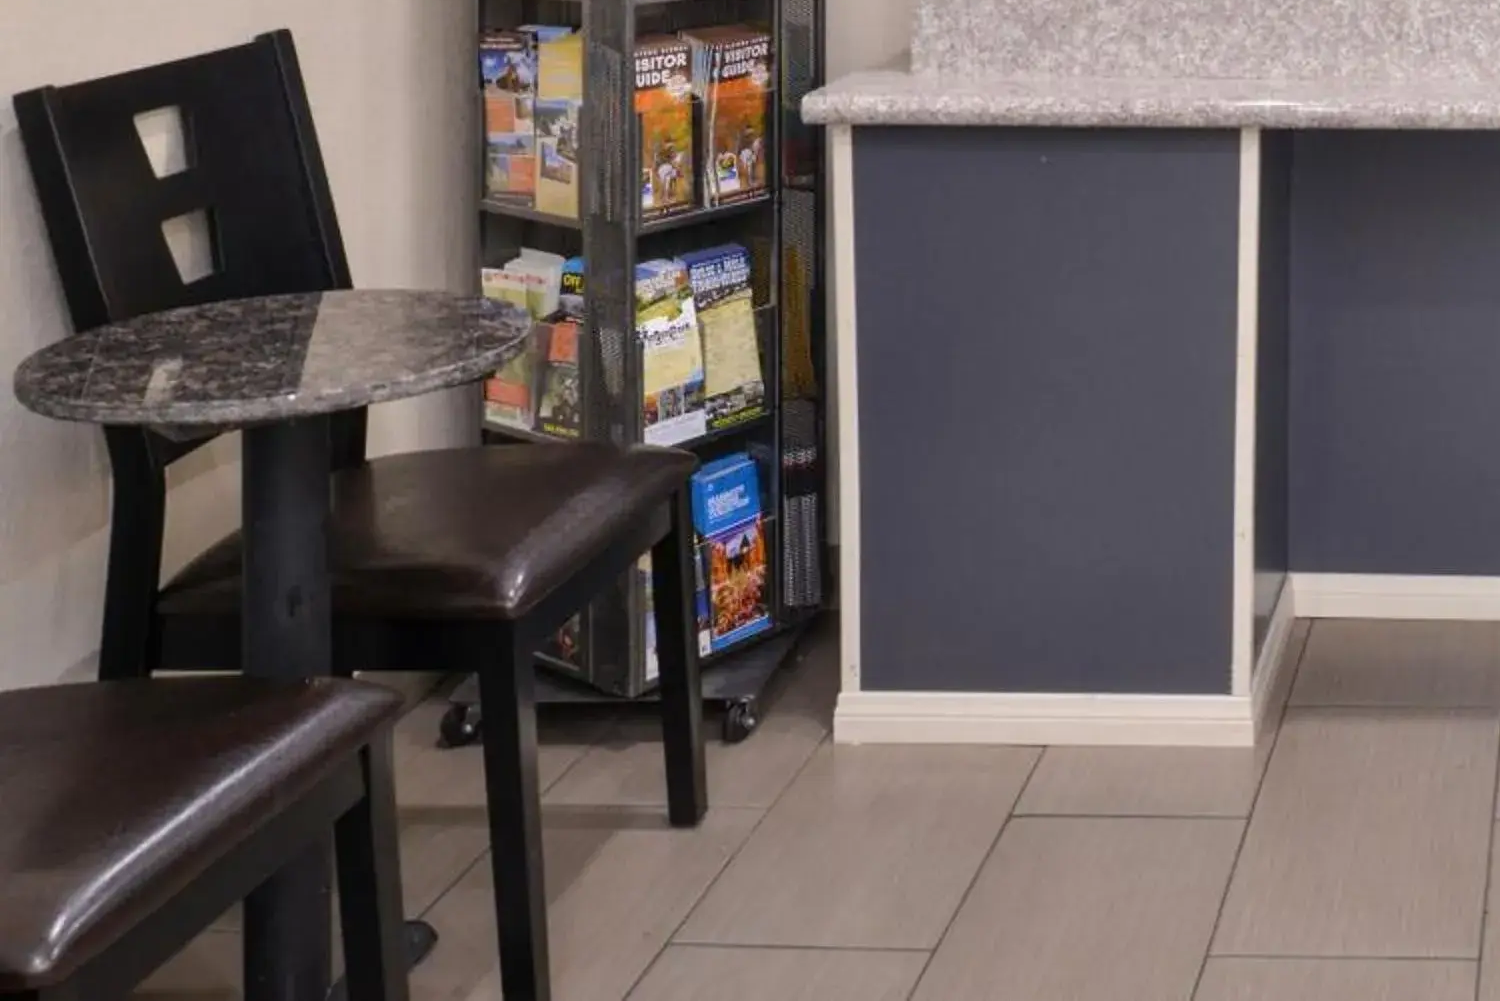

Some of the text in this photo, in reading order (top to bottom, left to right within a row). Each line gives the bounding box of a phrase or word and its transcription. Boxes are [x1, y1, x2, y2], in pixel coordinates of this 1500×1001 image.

[635, 52, 687, 72] ISITOR
[724, 42, 768, 63] VISITOR
[635, 69, 671, 88] UIDE
